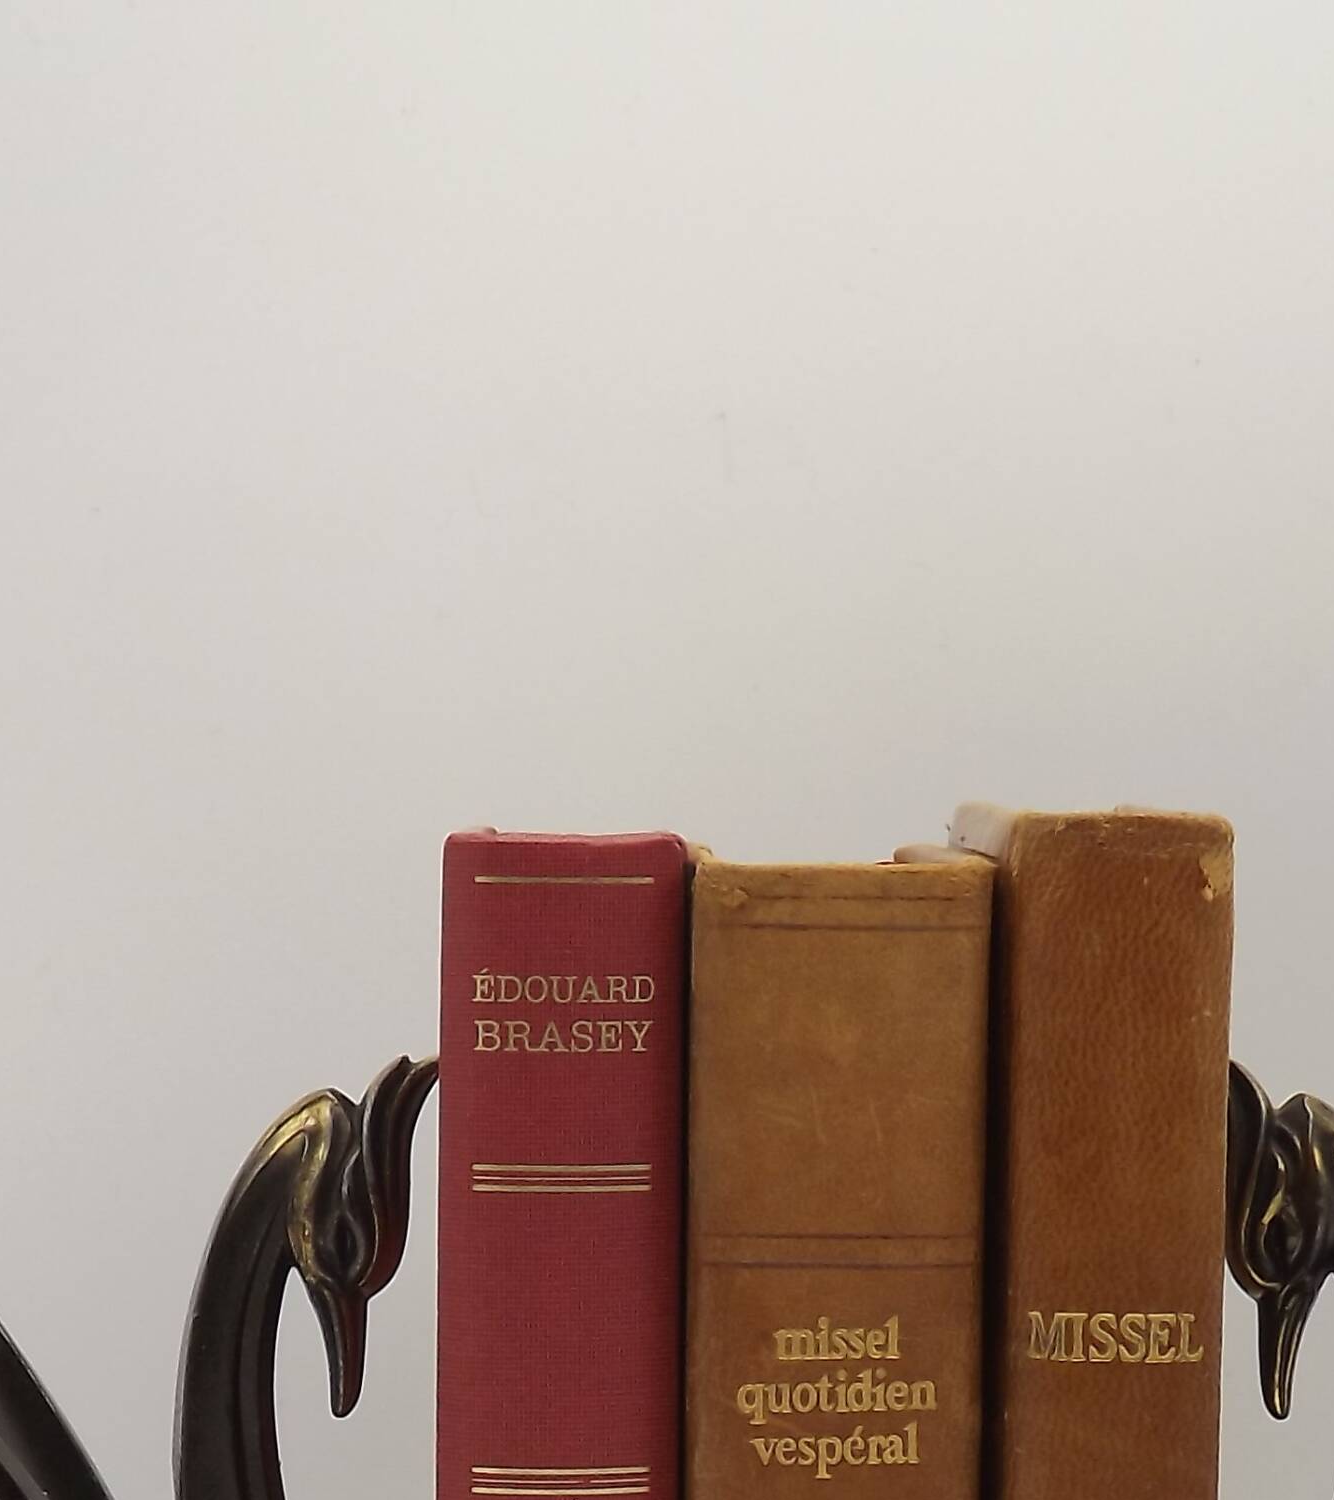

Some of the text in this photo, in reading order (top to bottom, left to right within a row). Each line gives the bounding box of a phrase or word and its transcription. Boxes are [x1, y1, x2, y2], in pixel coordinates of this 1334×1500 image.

[471, 968, 655, 1003] ÉDOUARD
[473, 1019, 654, 1053] BRASEY
[773, 1315, 901, 1361] missel
[1026, 1310, 1205, 1363] MISSEL
[736, 1368, 937, 1425] quotidien
[750, 1420, 920, 1481] vespéral
